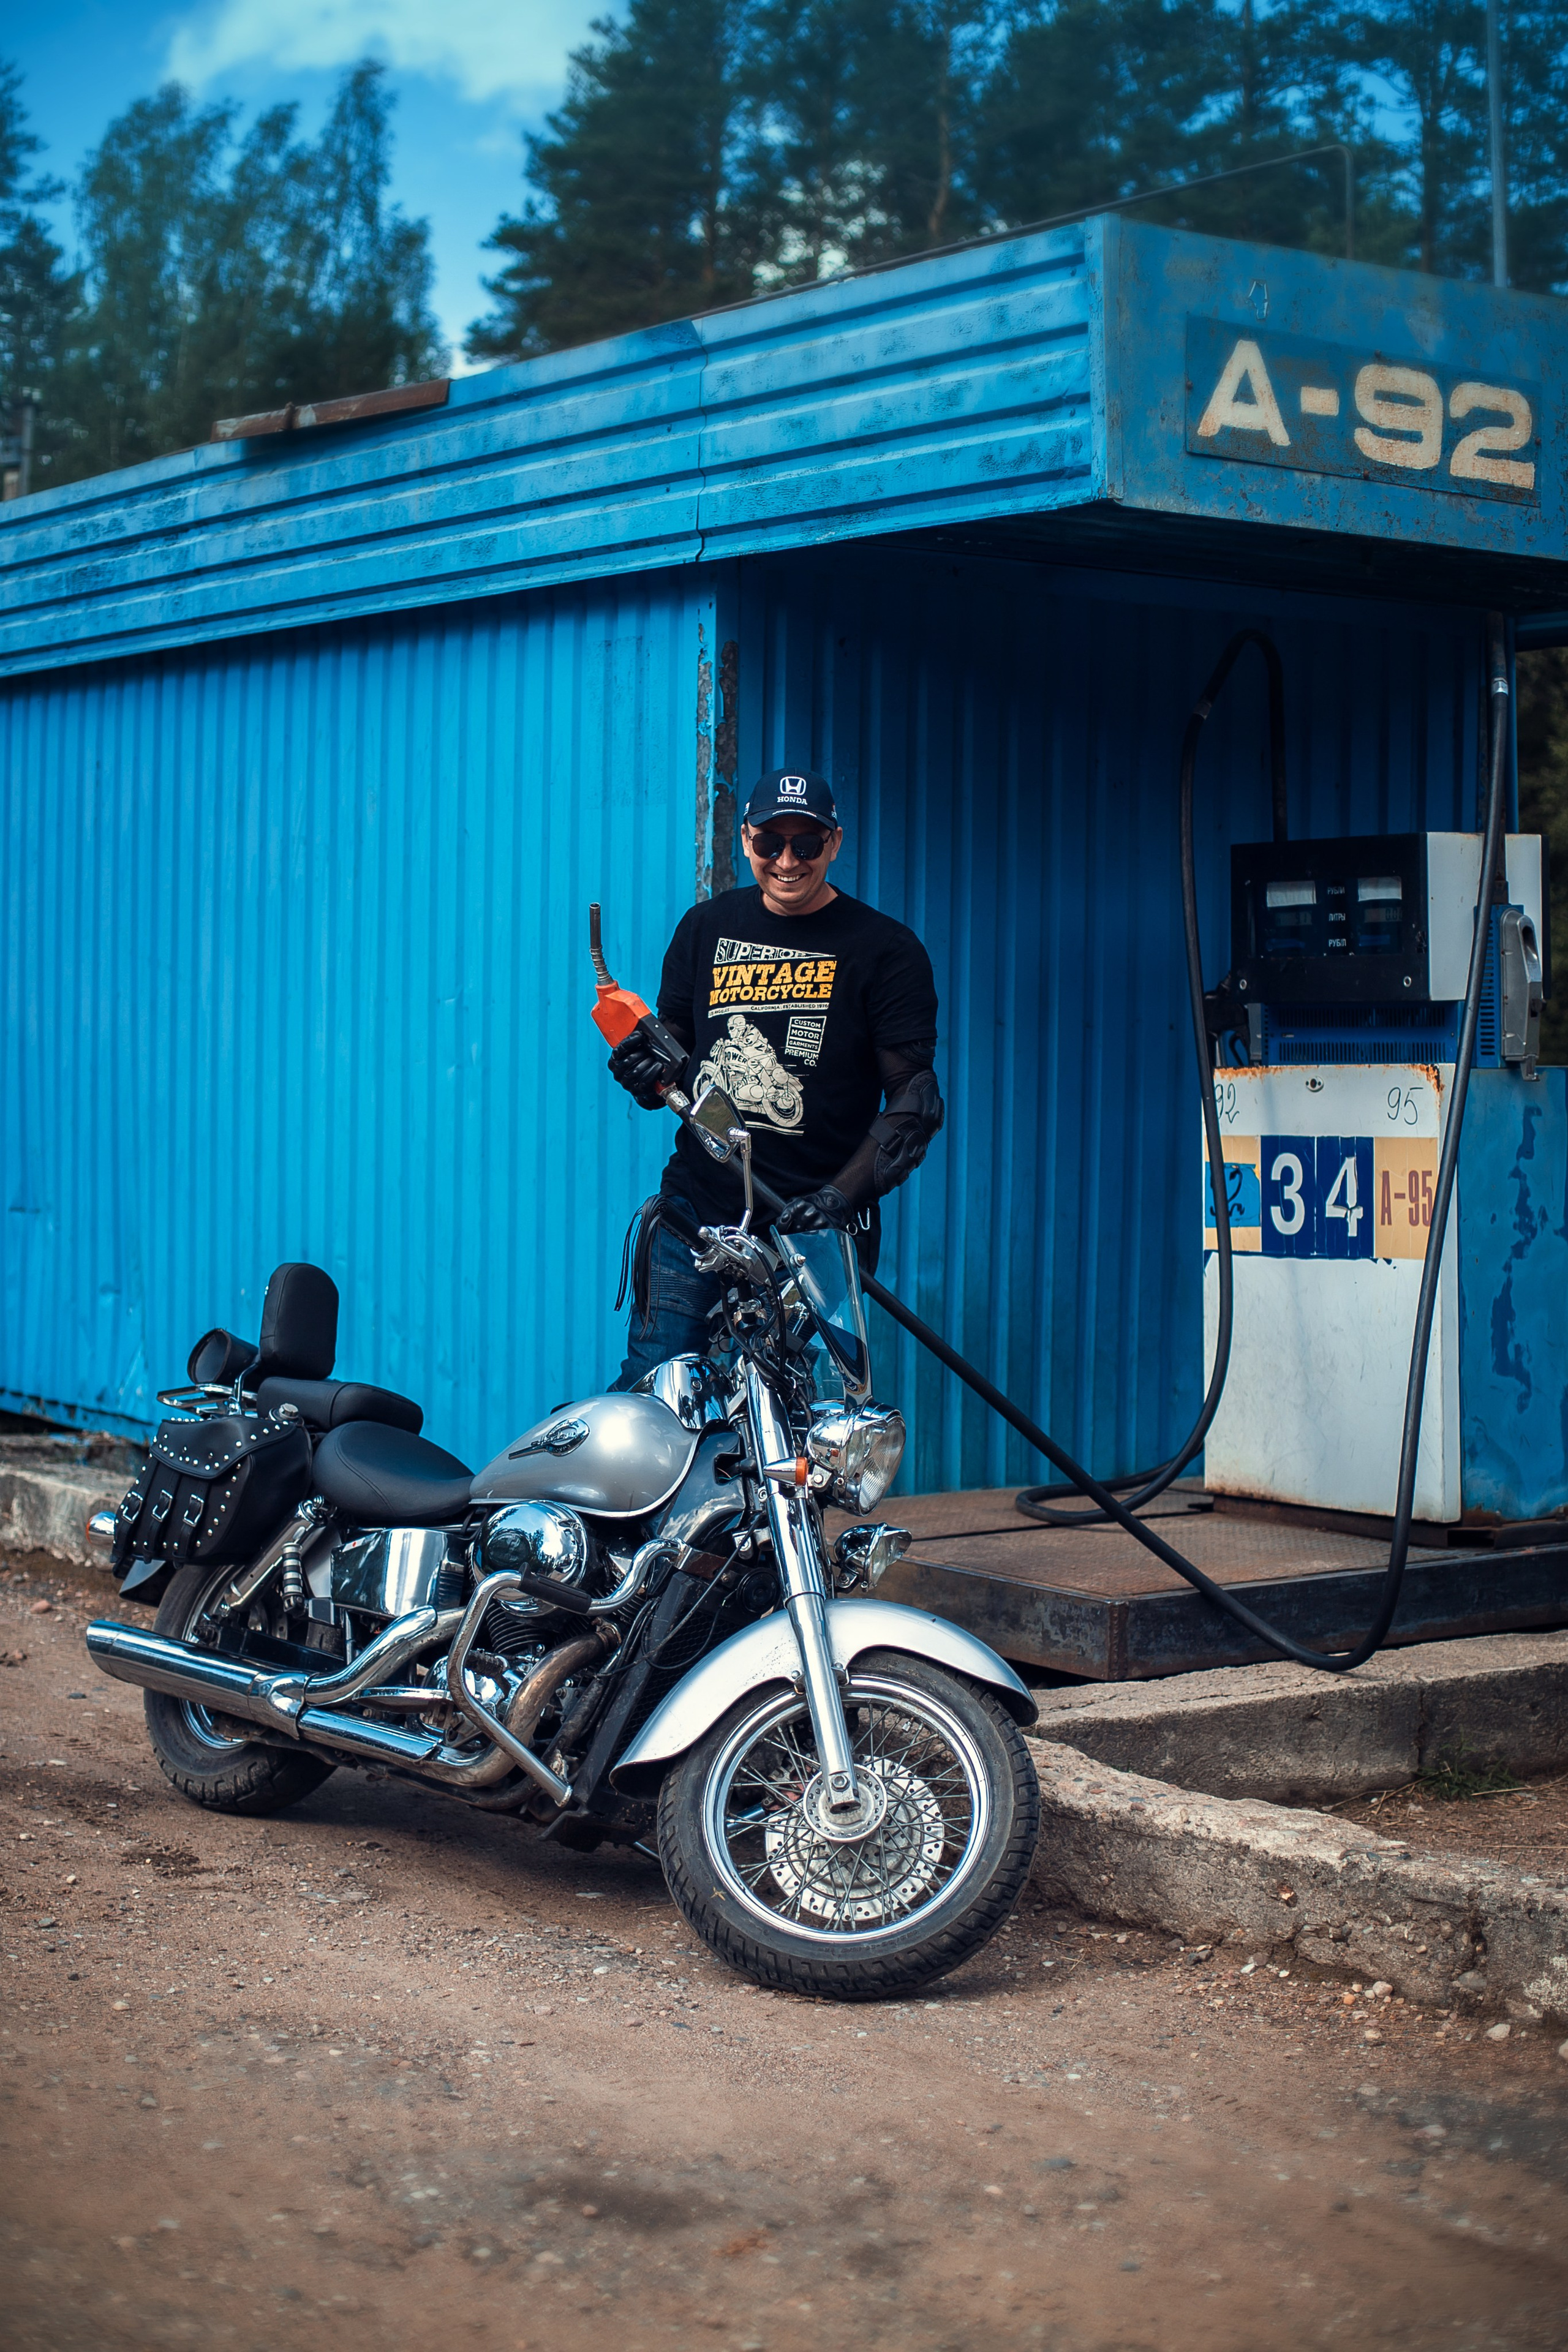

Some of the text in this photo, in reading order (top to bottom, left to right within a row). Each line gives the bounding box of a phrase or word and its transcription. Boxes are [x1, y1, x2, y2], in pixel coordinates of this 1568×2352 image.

[1197, 339, 1536, 490] A-92
[777, 796, 808, 805] HONDA
[1327, 886, 1345, 895] РУБЛИ
[1329, 913, 1346, 921] ЛИТРЫ
[716, 939, 808, 962] SUPERIOR
[712, 960, 837, 988] VINTAGE
[709, 983, 833, 1006] MOTORCYCLE
[794, 1019, 821, 1028] CUSTOM
[791, 1029, 820, 1039] MOTOR
[784, 1048, 819, 1060] PREMIUM
[789, 1041, 818, 1050] GARMENTS
[804, 1058, 817, 1067] CO.
[1215, 1083, 1240, 1123] 92
[1387, 1087, 1424, 1125] 95
[1270, 1152, 1364, 1237] 3 4
[1381, 1169, 1433, 1227] A-95
